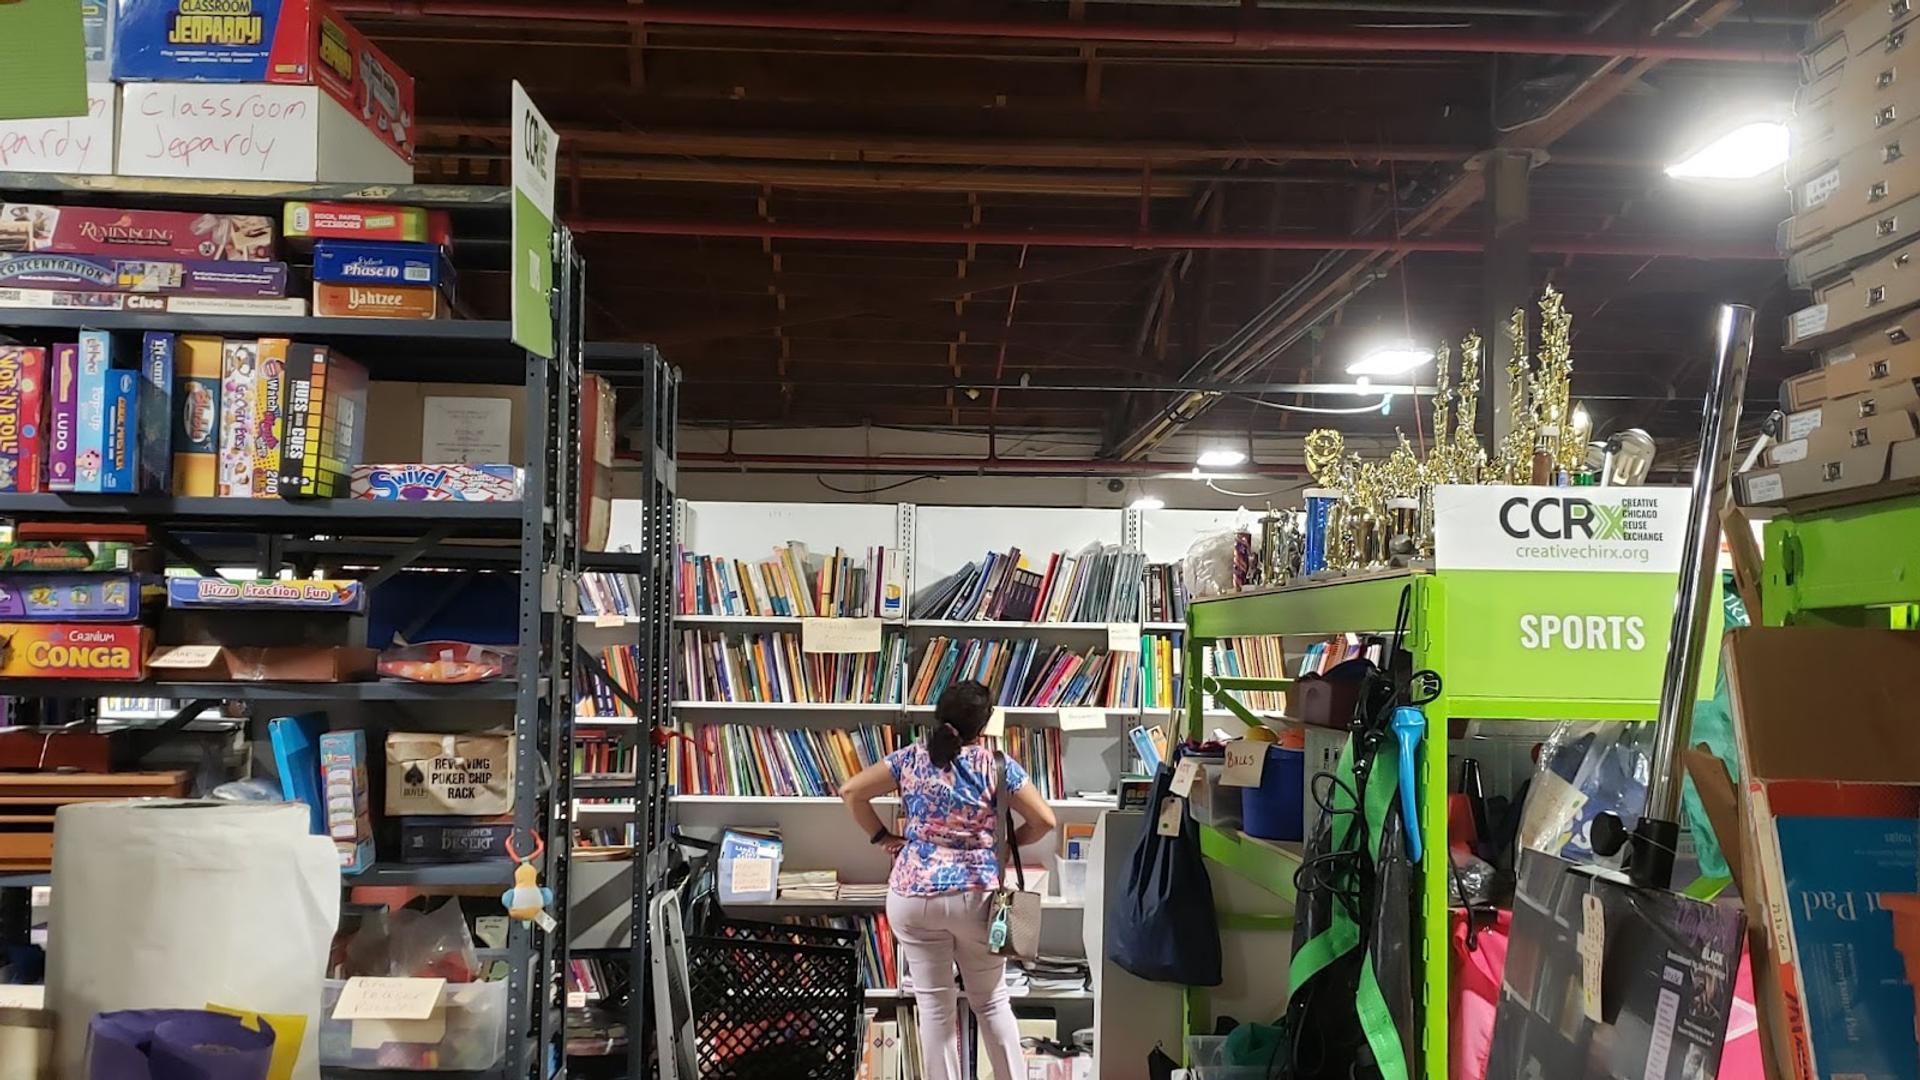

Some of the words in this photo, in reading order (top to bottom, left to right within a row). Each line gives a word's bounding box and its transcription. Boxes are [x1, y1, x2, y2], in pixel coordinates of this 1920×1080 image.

[181, 0, 250, 13] CLASSROOM
[168, 15, 263, 44] JEOPARDY!
[141, 92, 307, 120] Classroom
[145, 125, 277, 172] Jeopardy
[343, 264, 384, 277] Phase
[386, 267, 399, 277] 10
[127, 295, 165, 310] Clue
[348, 287, 403, 309] Yahtzee
[266, 379, 279, 413] Watch
[294, 380, 310, 412] HUES
[56, 412, 69, 451] LUDO
[289, 427, 306, 460] CUES
[266, 470, 279, 493] 200
[369, 469, 448, 500] Swivel
[1621, 498, 1659, 508] CREATIVE
[1621, 509, 1658, 519] CHICAGO
[1622, 520, 1648, 530] REUSE
[1622, 531, 1664, 542] EXCHANGE
[1516, 543, 1649, 563] creativechirx.org
[201, 583, 239, 598] Pizza
[243, 584, 300, 599] Fraction
[303, 586, 330, 599] Fun
[1519, 613, 1646, 651] SPORTS
[434, 758, 490, 770] REVVING
[431, 772, 465, 785] POKER
[468, 772, 492, 784] CHIP
[447, 787, 476, 799] RACK
[1800, 890, 1857, 922] Pad
